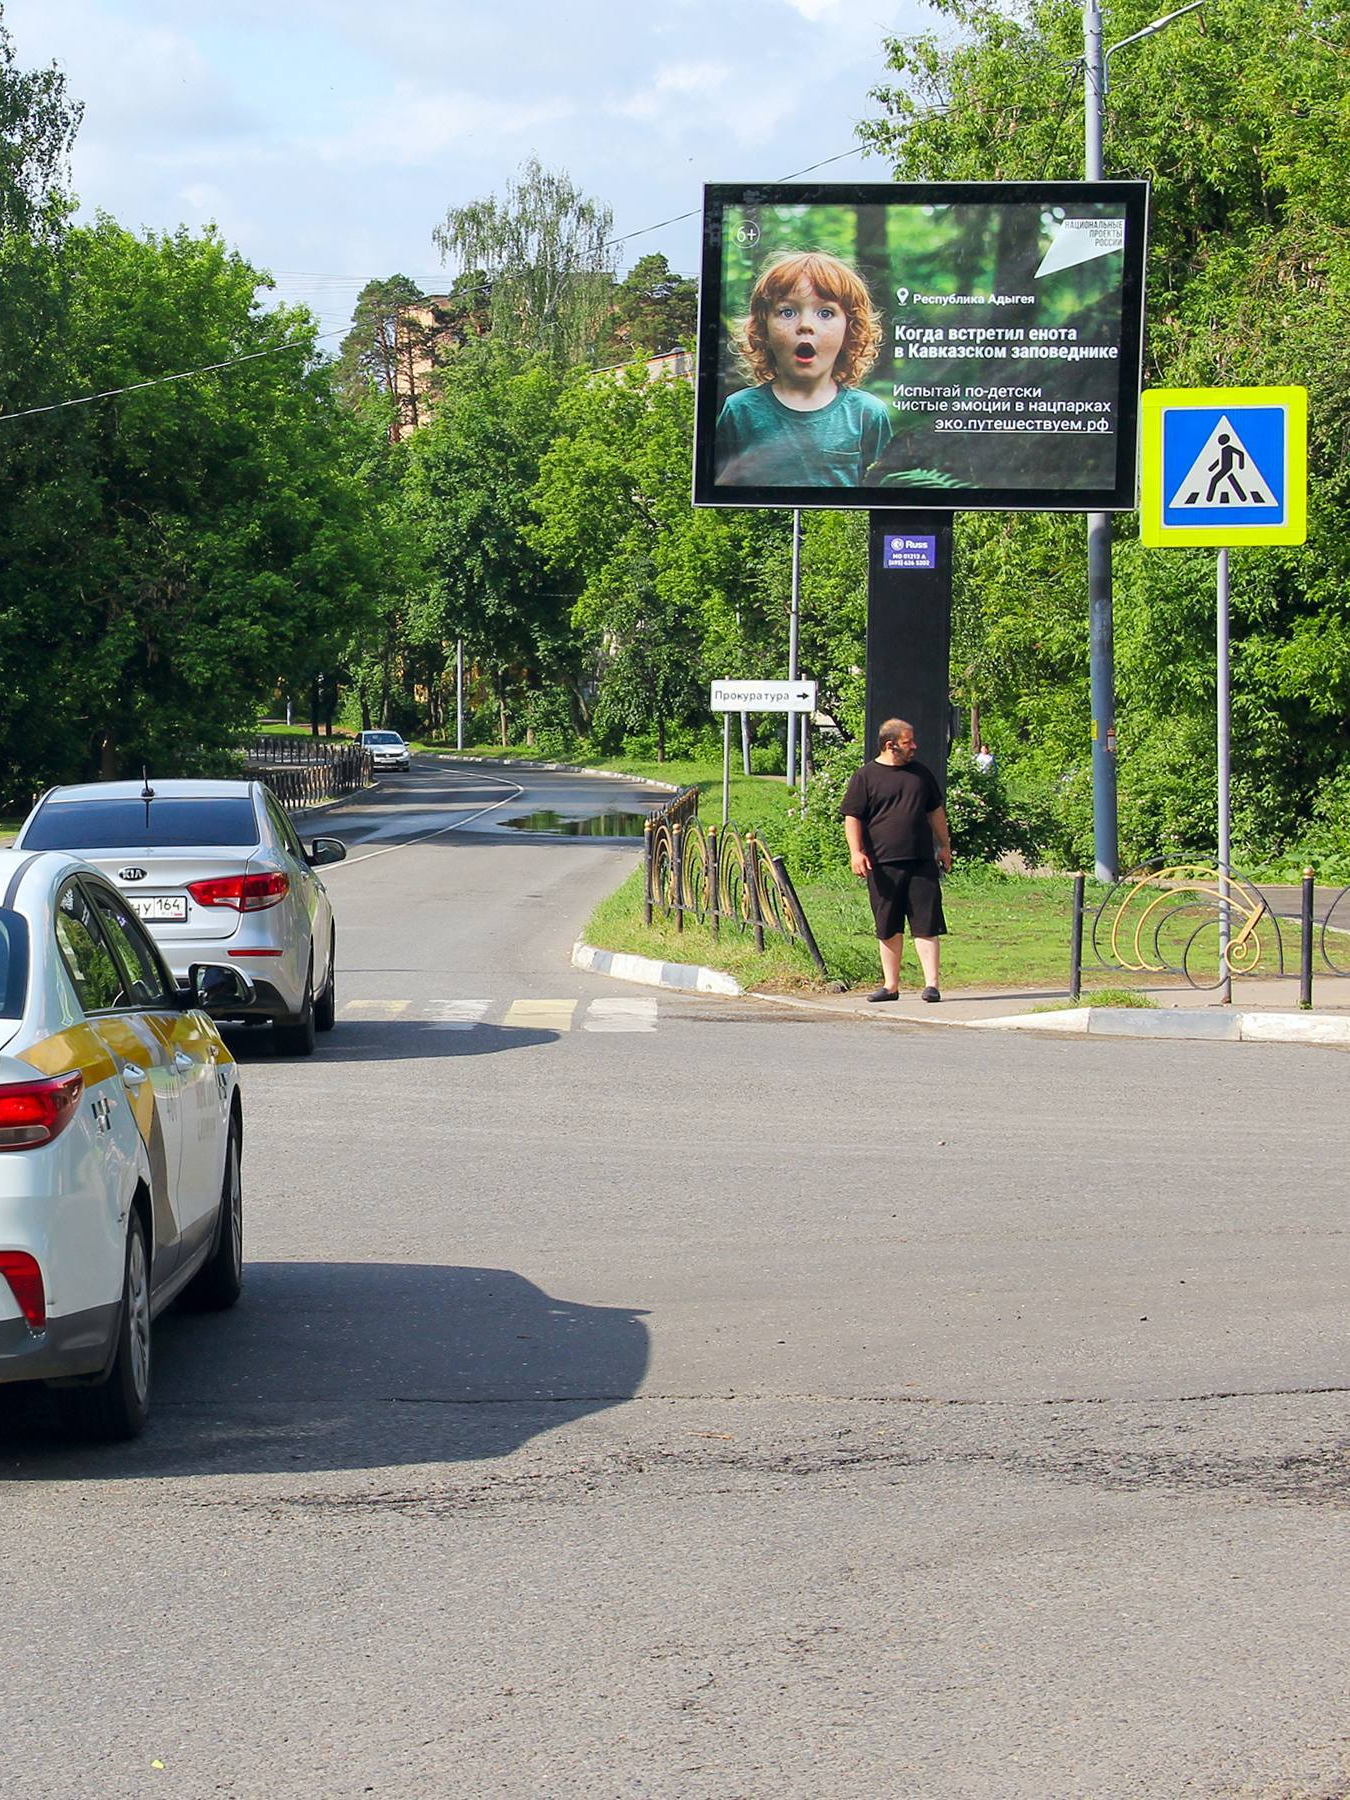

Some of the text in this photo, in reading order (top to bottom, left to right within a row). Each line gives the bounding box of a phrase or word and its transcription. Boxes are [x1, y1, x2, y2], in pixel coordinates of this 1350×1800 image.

[1065, 221, 1123, 229] НАЦИОНАЛЬНЫЕ
[737, 226, 756, 242] 6+
[1090, 230, 1123, 238] ПРОЕКТЫ
[1095, 239, 1123, 247] РОССИИ
[913, 294, 1035, 306] Республика Адыгея
[895, 326, 1077, 343] Когда встретил енота
[895, 344, 1118, 361] в Кавказском заповеднике
[893, 384, 1042, 398] Испытай по-детски
[892, 401, 1112, 415] чистые эмоции в нацпарках
[935, 418, 1109, 432] эко.путешествуем.рф
[905, 540, 928, 549] Russ
[715, 690, 790, 703] Прокуратура
[122, 869, 142, 879] KIA
[156, 898, 180, 911] 164
